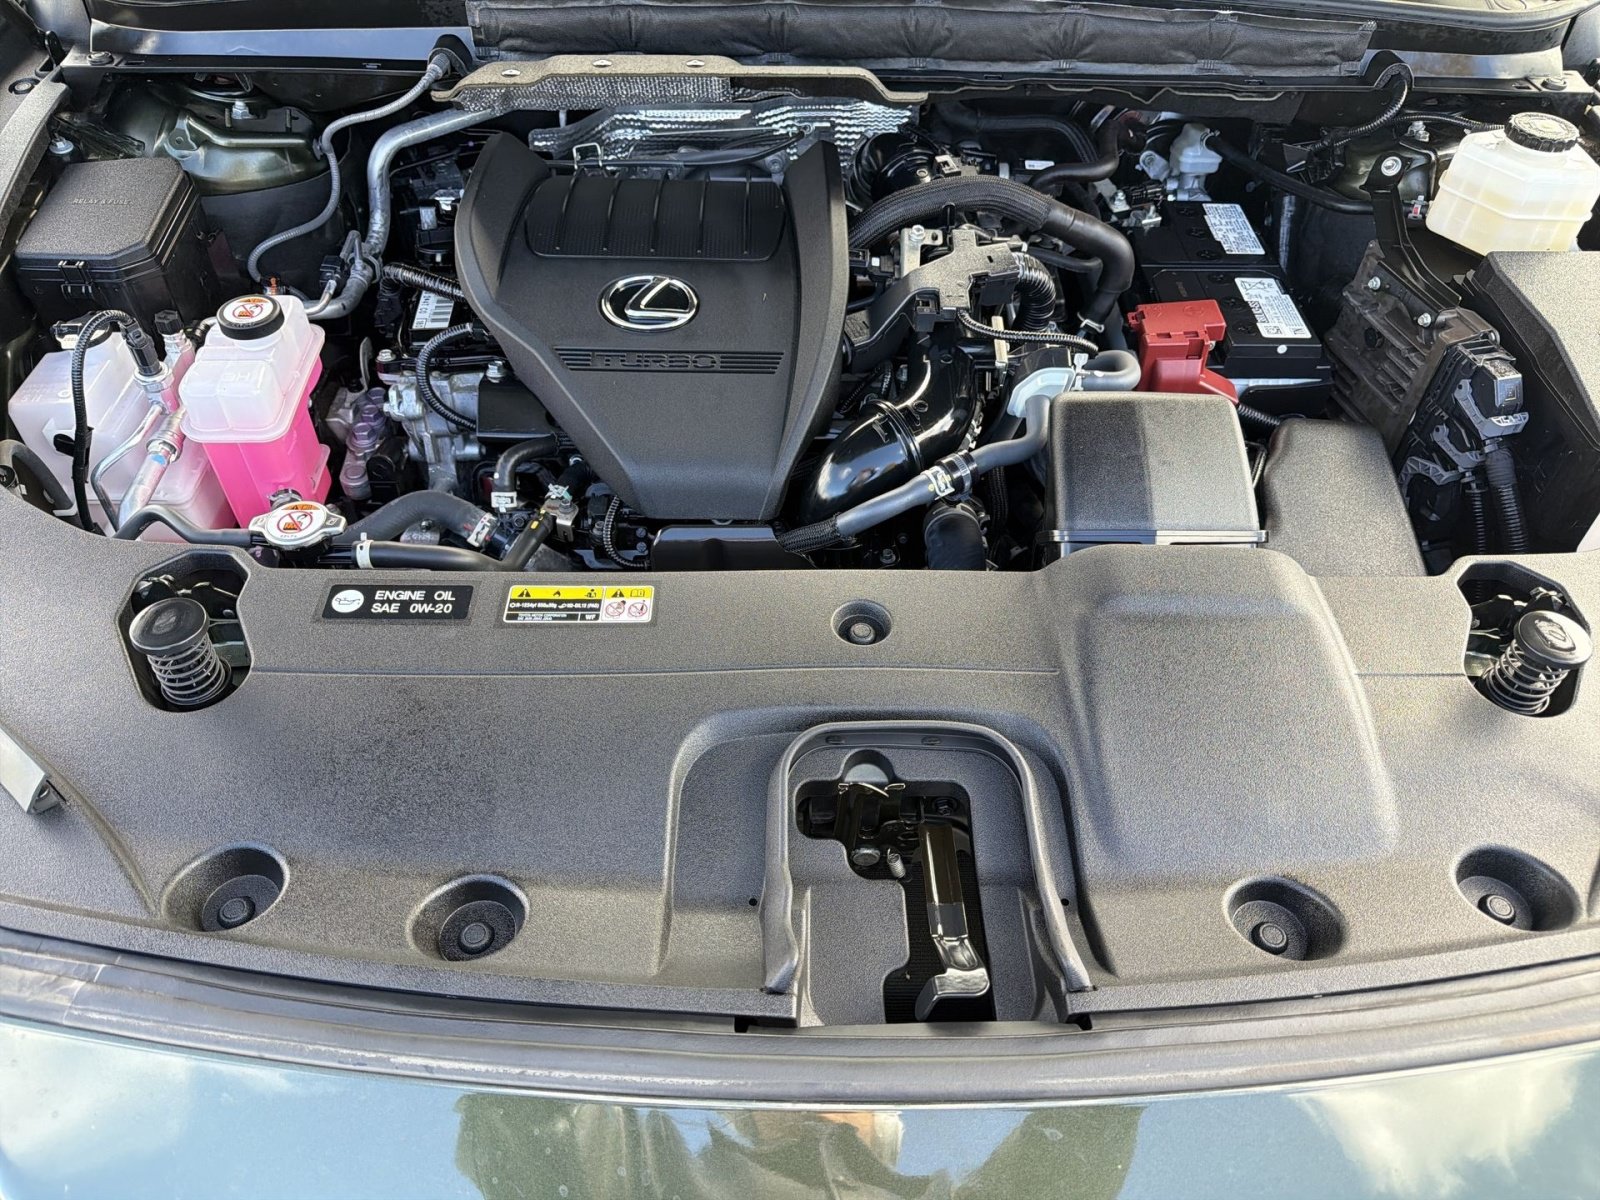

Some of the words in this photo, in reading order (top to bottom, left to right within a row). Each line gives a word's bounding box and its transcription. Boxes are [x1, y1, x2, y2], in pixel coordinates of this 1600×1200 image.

[595, 352, 717, 369] TURBO
[374, 590, 426, 600] ENGINE
[434, 590, 456, 601] OIL
[370, 602, 401, 613] SAE
[409, 603, 453, 613] 0W-20
